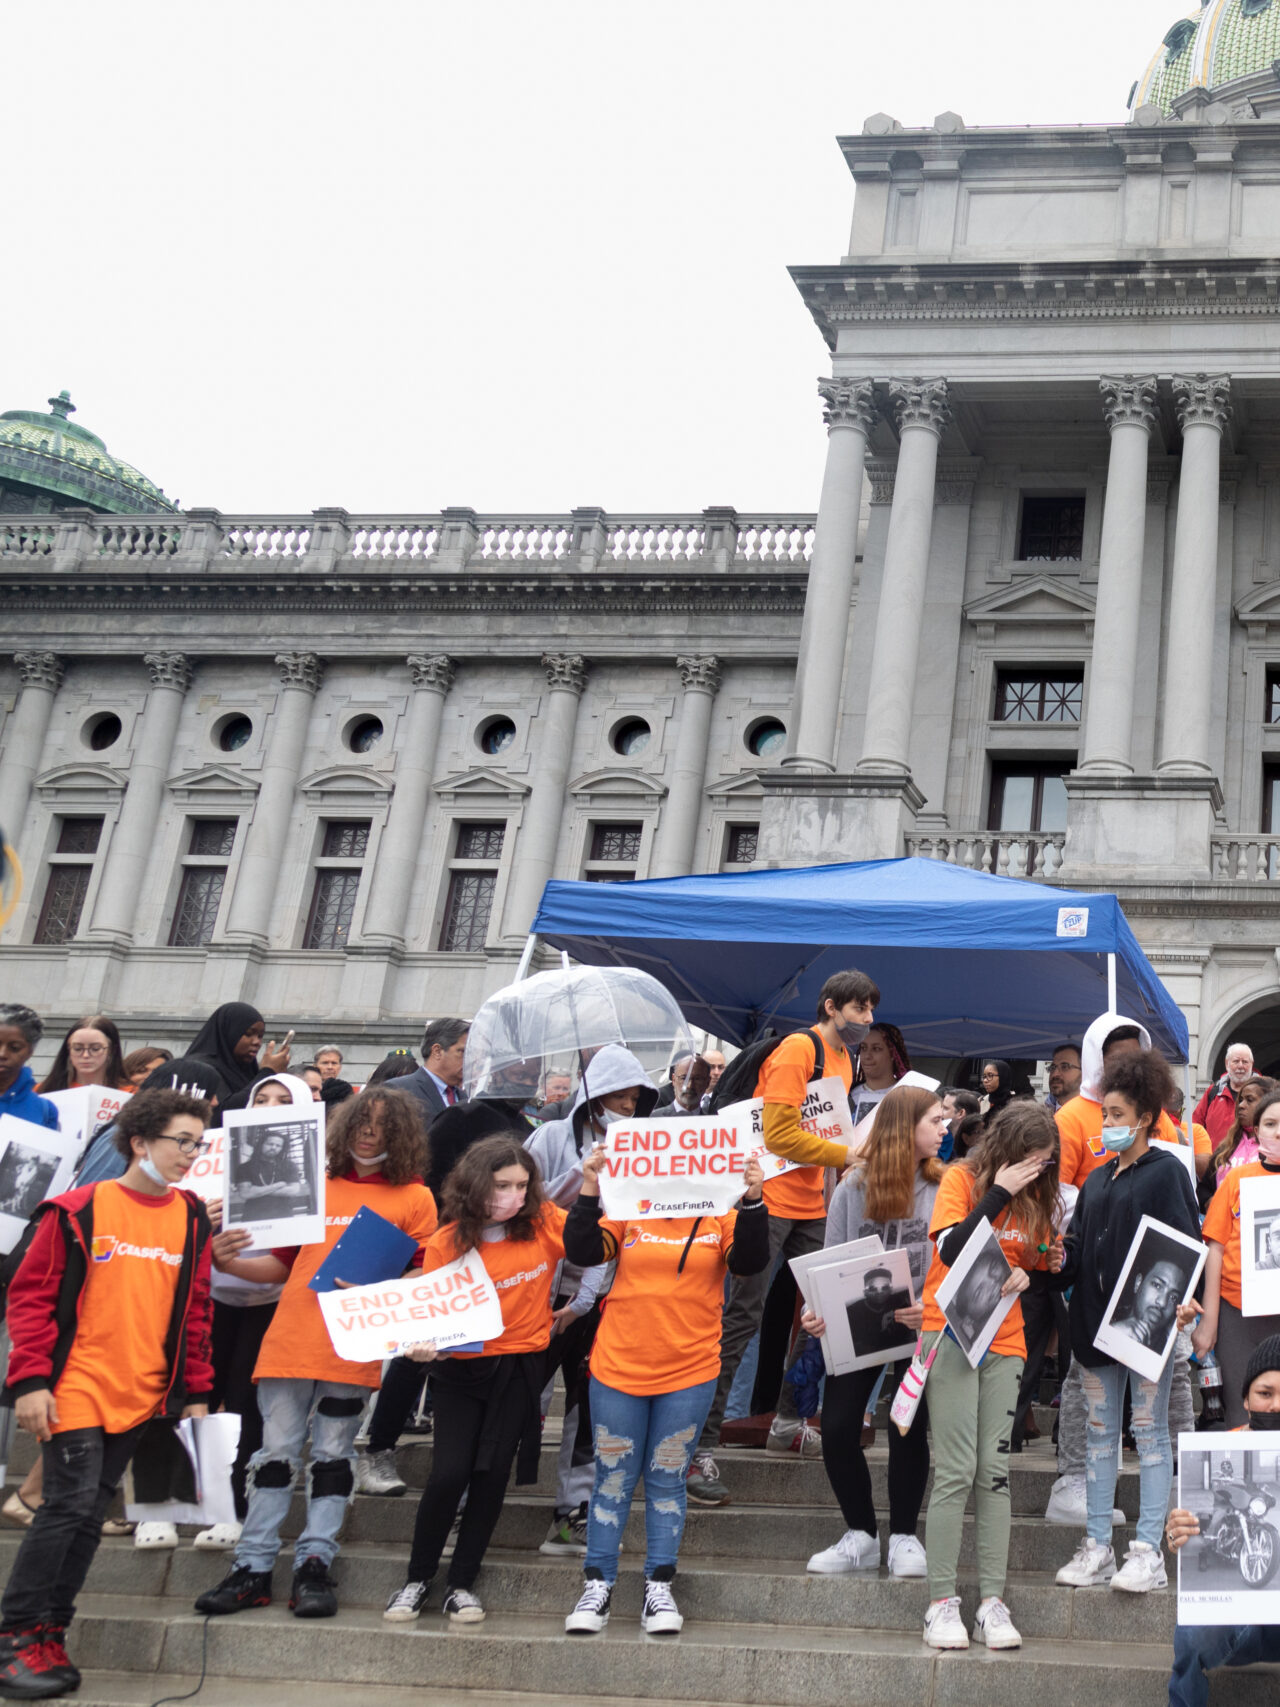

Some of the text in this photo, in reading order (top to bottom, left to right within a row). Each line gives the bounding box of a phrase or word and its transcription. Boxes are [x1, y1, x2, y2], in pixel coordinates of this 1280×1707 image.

[614, 1127, 737, 1152] END GUN
[605, 1152, 745, 1178] VIOLENCE
[336, 1283, 490, 1332] VIOLENCE
[339, 1265, 475, 1313] END GUN
